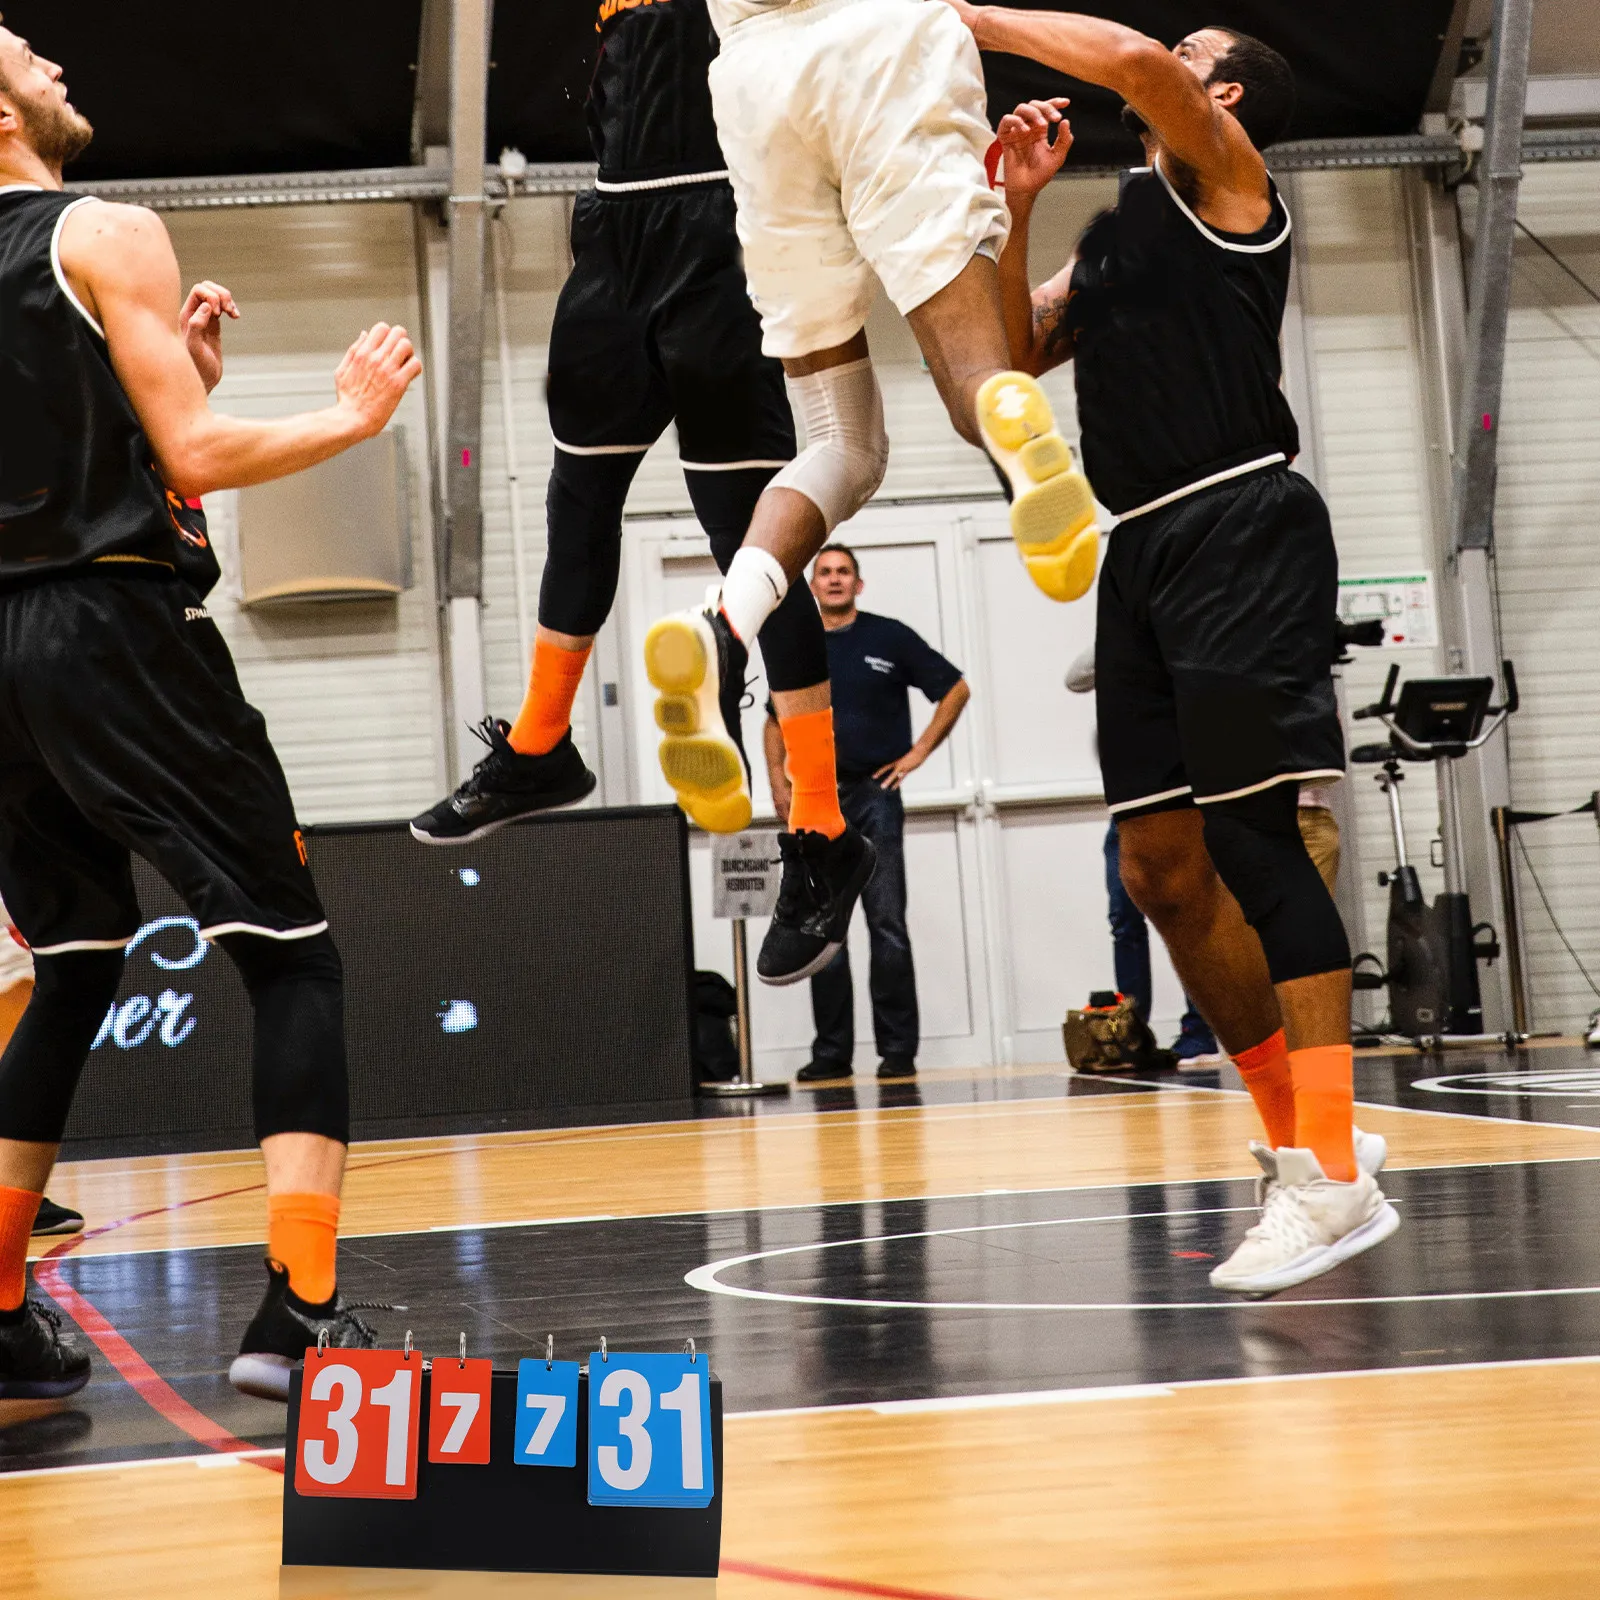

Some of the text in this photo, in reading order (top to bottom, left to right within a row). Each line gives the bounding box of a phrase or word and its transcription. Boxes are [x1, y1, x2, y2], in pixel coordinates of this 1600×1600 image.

[303, 1363, 704, 1490] 31 7 7 31
